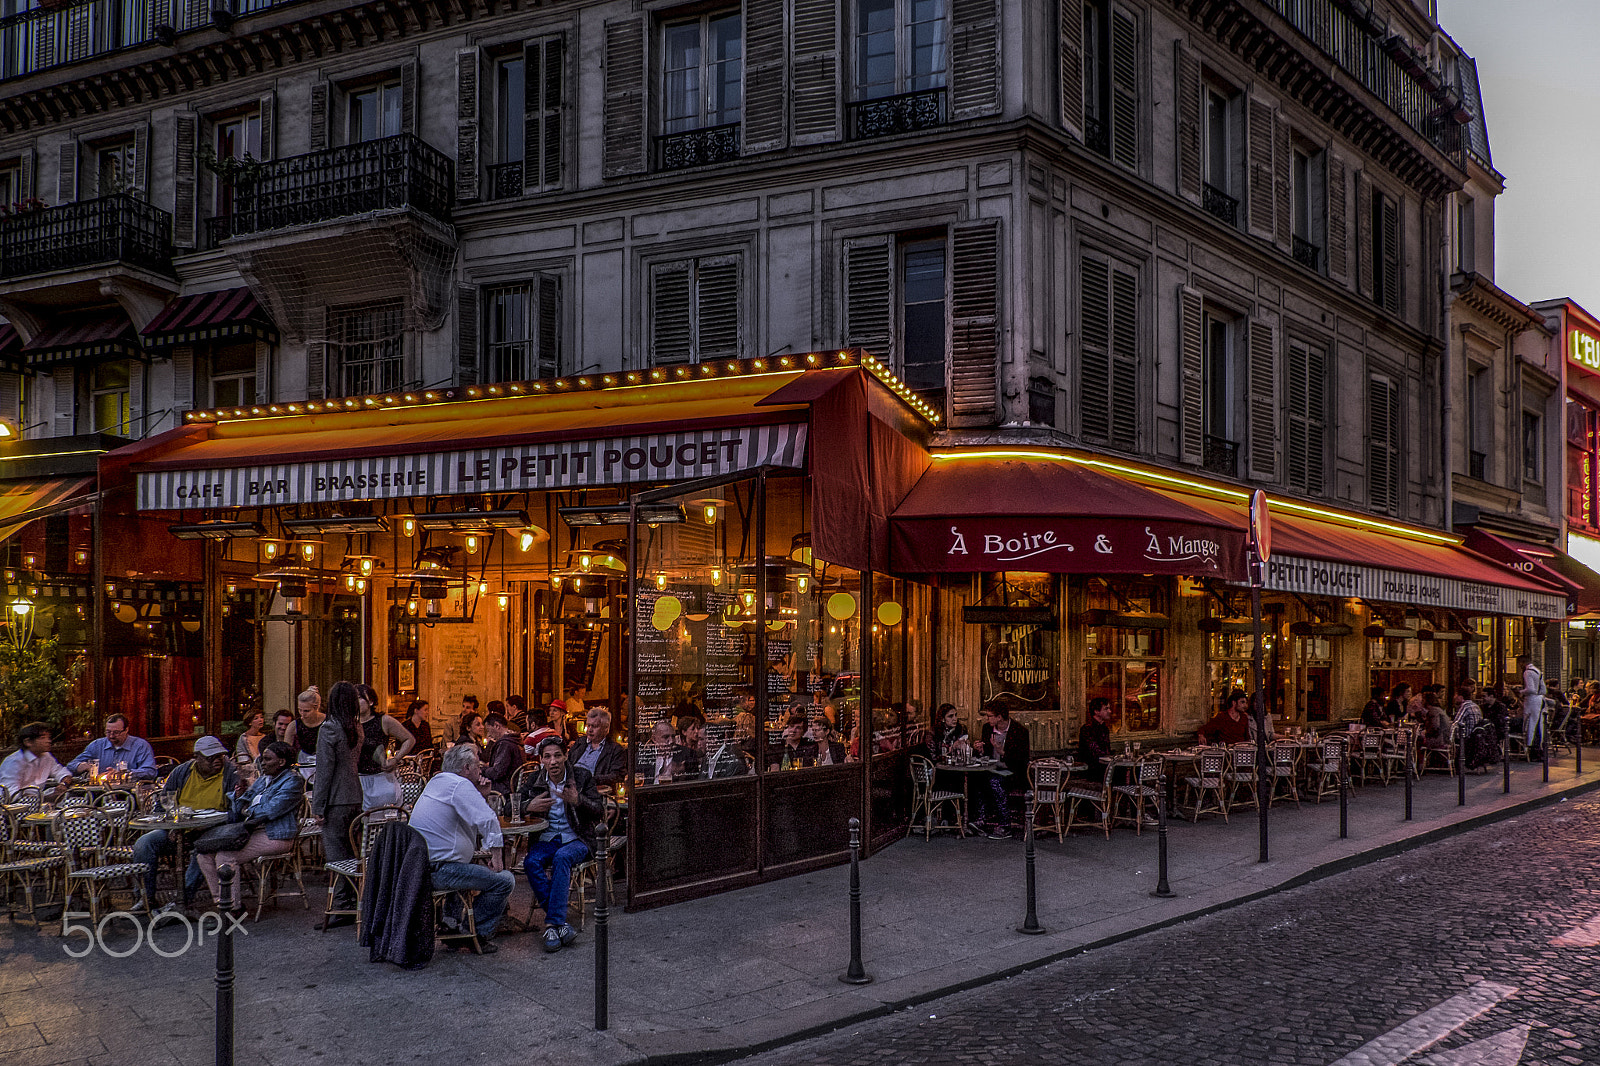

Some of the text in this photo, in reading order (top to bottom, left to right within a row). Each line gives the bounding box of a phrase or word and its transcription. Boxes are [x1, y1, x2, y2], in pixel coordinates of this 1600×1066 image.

[176, 438, 743, 499] CAFE BAR BRASSERIE LE PETIT POUCET
[983, 530, 1057, 554] Boire
[1094, 534, 1113, 554] &
[1168, 535, 1220, 557] Manger
[1269, 561, 1440, 598] PETIT POUCET TOUS LES JOURS
[1566, 602, 1576, 613] 4
[1004, 669, 1050, 684] CONVIVIAL
